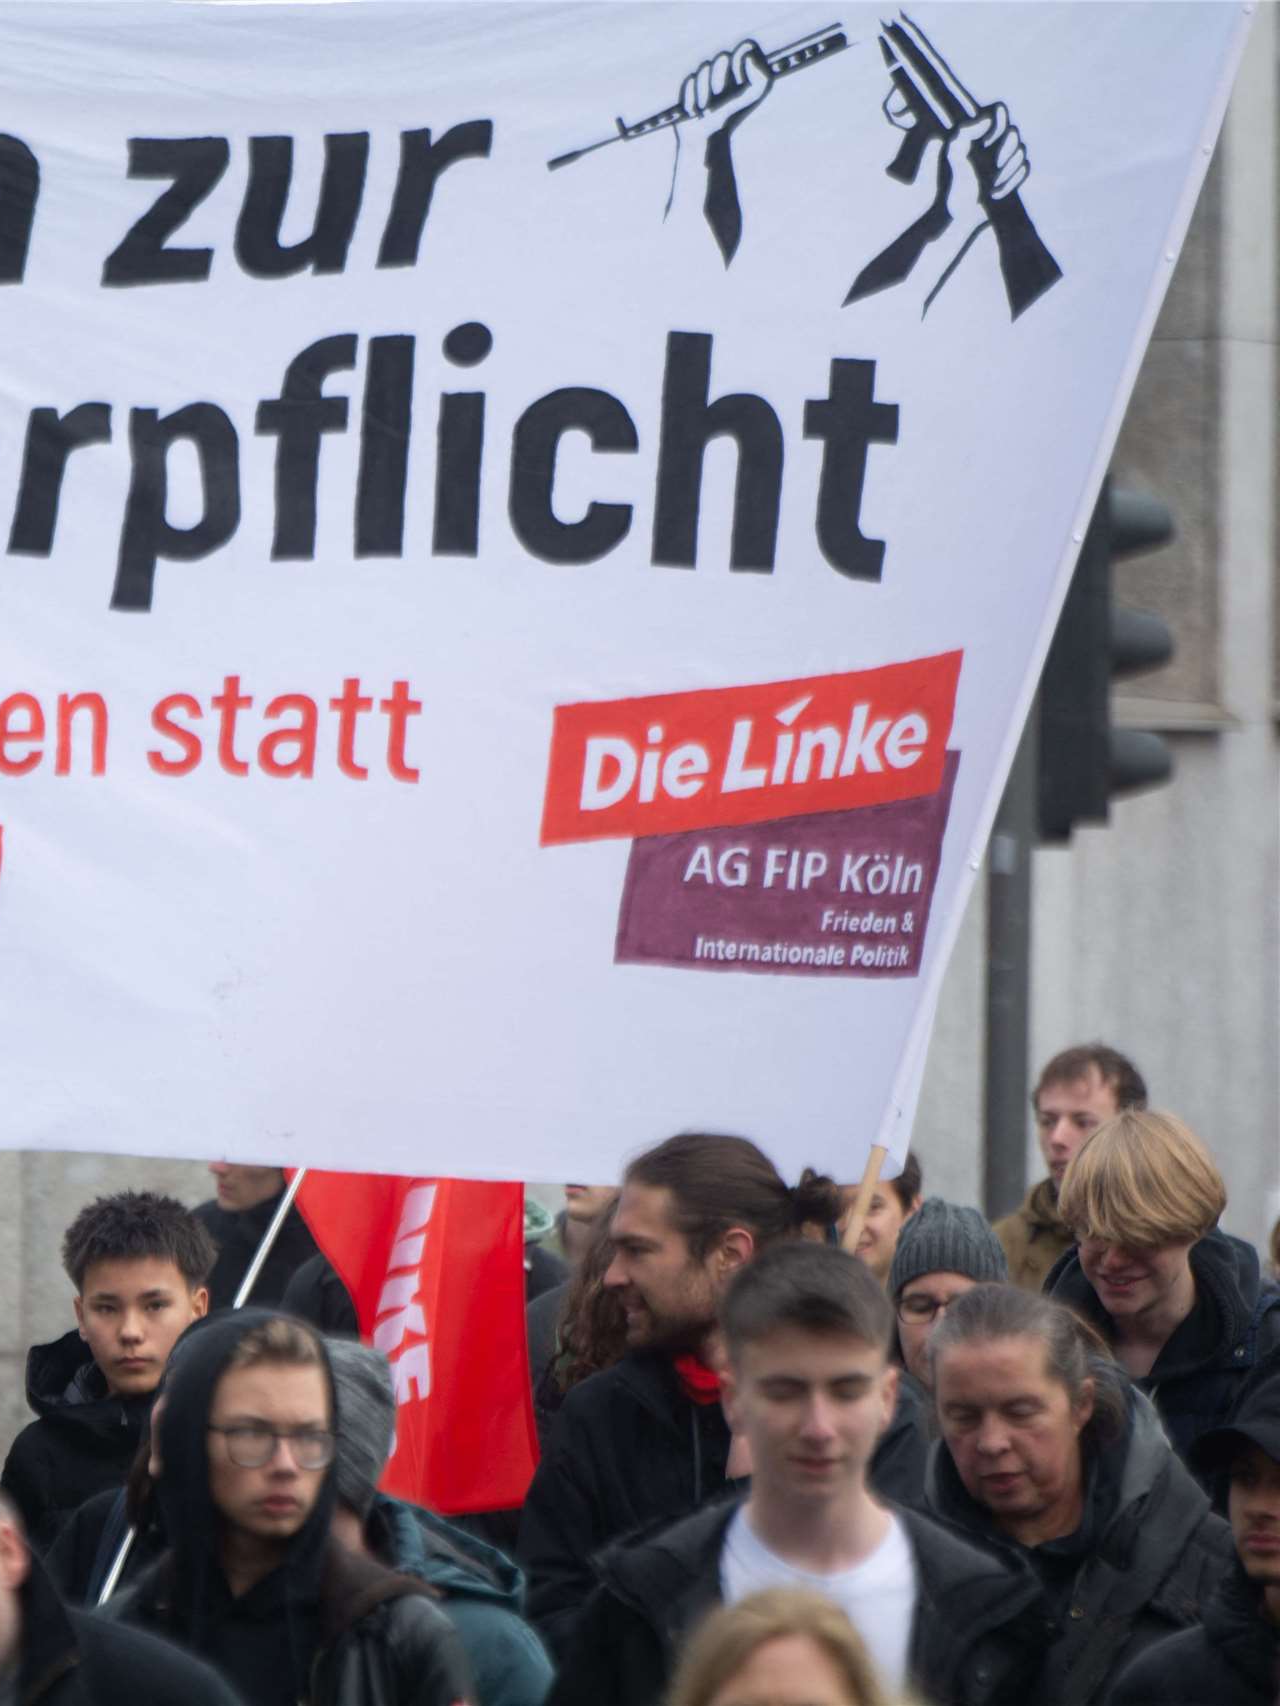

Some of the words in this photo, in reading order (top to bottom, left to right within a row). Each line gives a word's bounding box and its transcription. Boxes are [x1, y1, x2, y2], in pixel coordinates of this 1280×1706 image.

[101, 118, 494, 288] zur
[147, 675, 423, 784] statt
[579, 723, 711, 811] Die
[721, 696, 928, 793] Linke
[683, 844, 750, 887] AG
[763, 848, 827, 891] FIP
[839, 853, 923, 895] Köln
[695, 937, 845, 966] Internationale
[850, 944, 909, 968] Politik
[820, 910, 897, 933] Frieden
[901, 911, 914, 933] &
